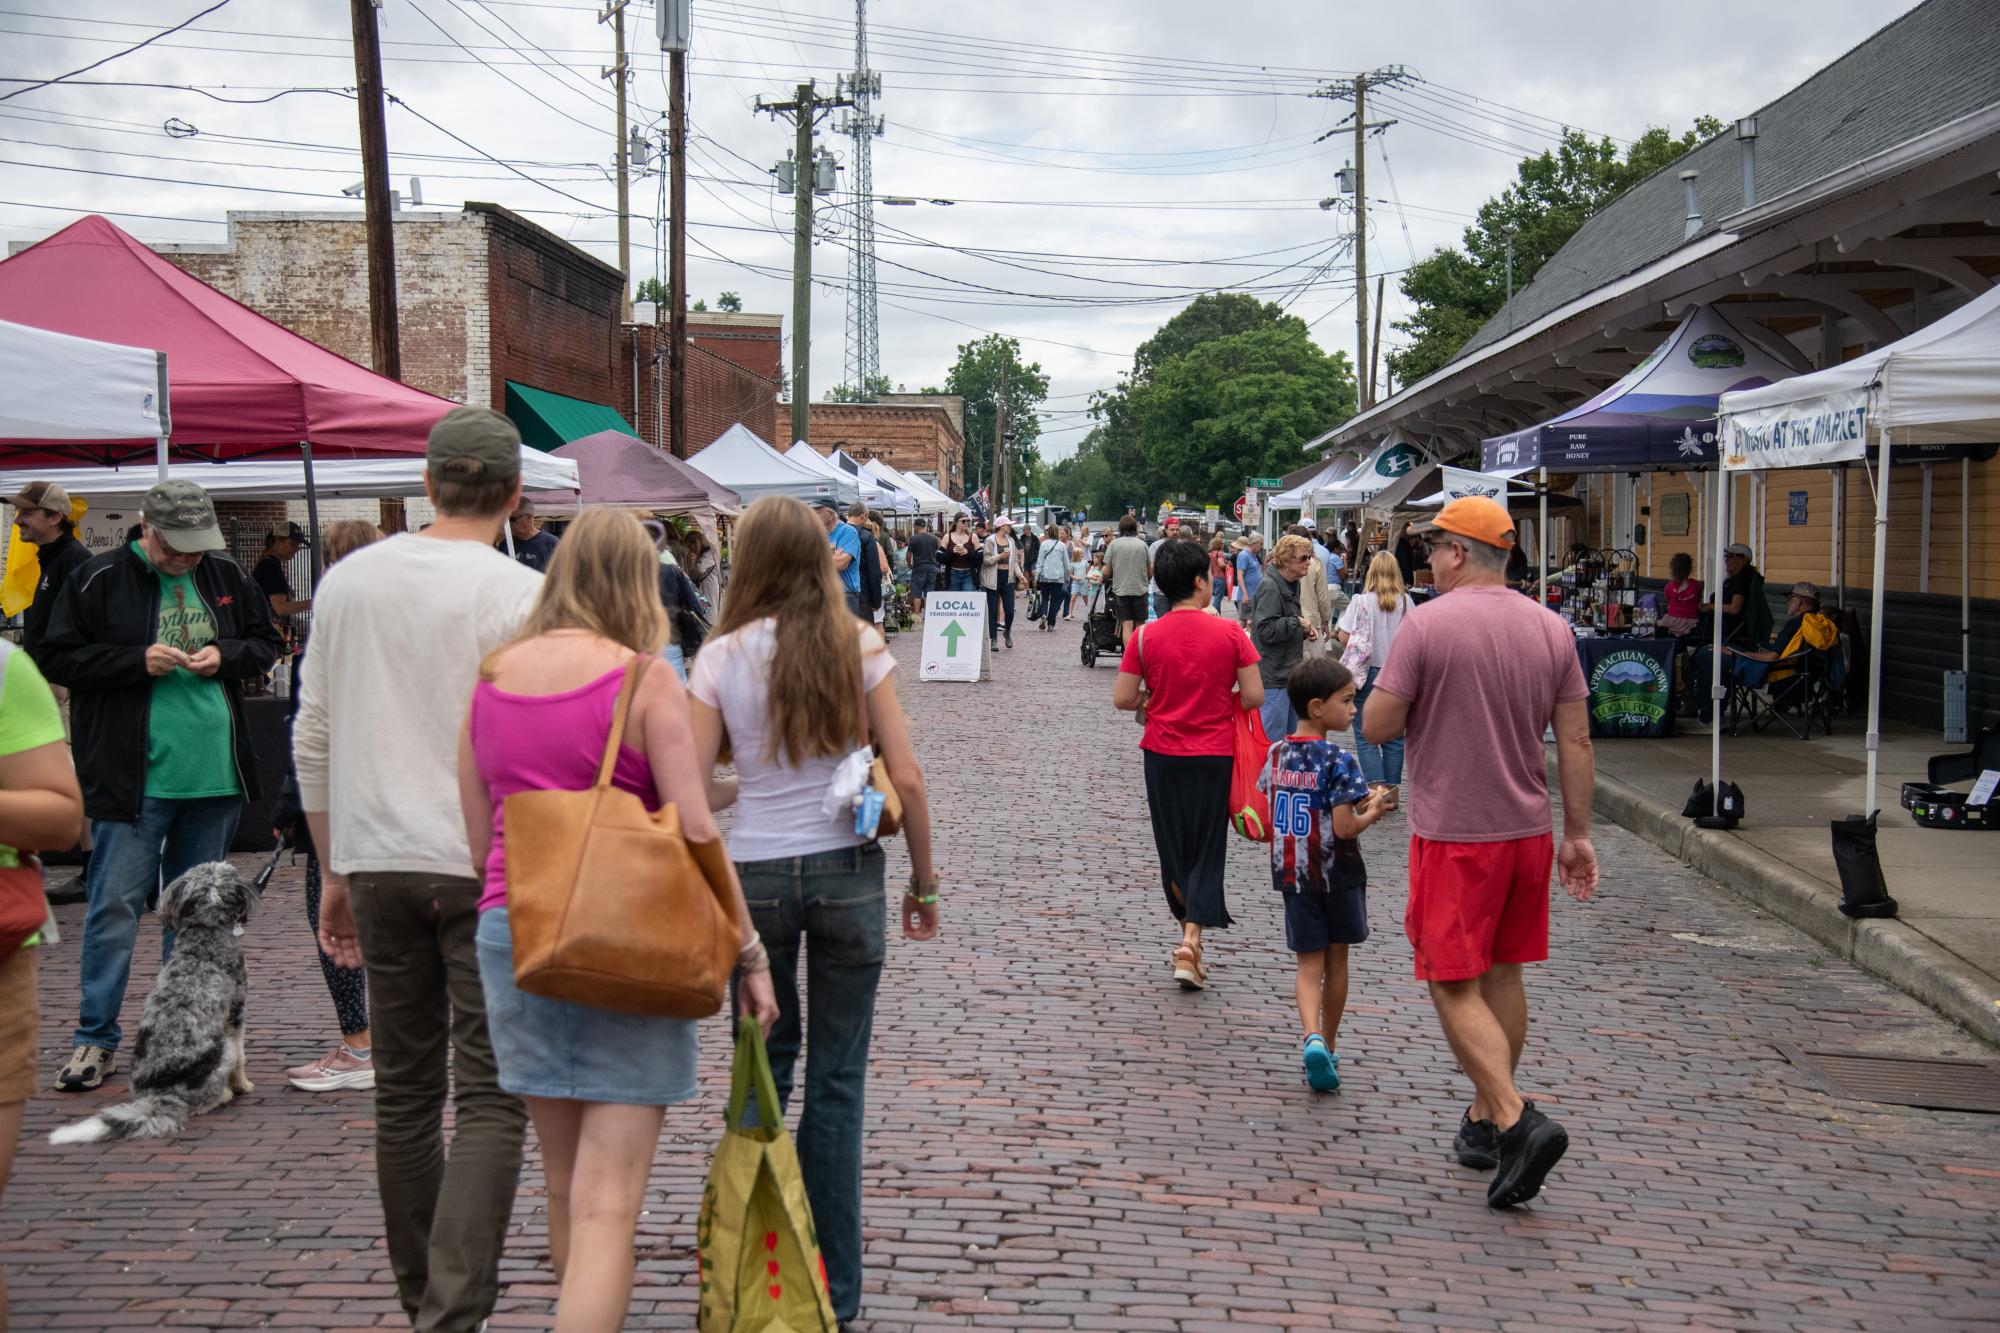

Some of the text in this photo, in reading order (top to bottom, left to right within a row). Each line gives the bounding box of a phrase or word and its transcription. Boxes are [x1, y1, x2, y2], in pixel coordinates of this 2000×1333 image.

[1744, 407, 1866, 452] MUSIC AT THE MARKET
[1386, 453, 1418, 474] H
[935, 601, 975, 610] LOCAL
[158, 606, 210, 637] ythm
[1590, 650, 1668, 693] APPALACHIAN GROWN
[1595, 701, 1661, 718] LOCAL FOOD
[1273, 790, 1312, 839] 46
